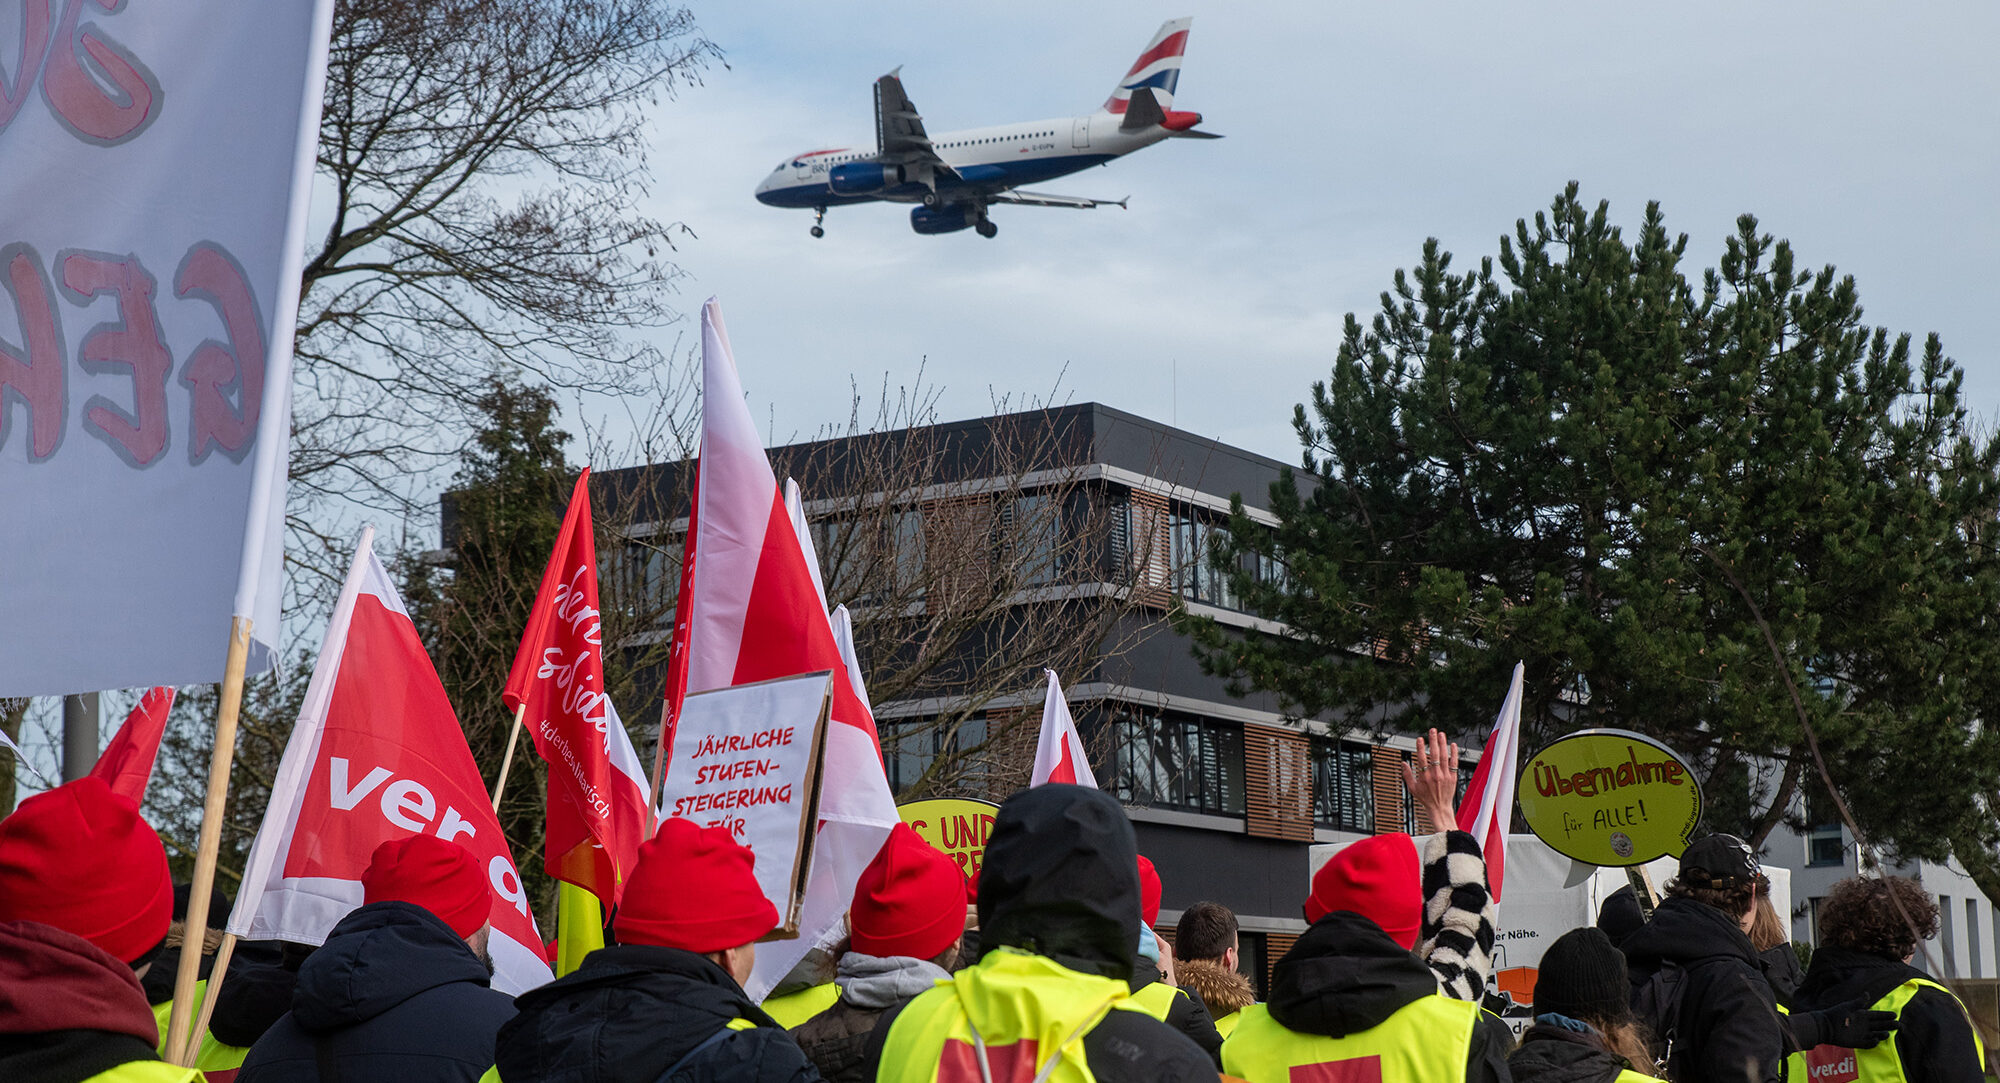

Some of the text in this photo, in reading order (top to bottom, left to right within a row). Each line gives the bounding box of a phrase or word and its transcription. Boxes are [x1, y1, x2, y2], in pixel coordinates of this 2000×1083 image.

[692, 727, 794, 759] JÄHRLICHE
[695, 759, 780, 784] STUFEN-
[1534, 746, 1684, 797] Übernahme
[672, 783, 792, 816] STEIGERUNG
[941, 814, 996, 849] UND
[1563, 799, 1648, 840] für ALLE!
[1508, 929, 1539, 939] Nähe.
[1810, 1057, 1854, 1078] ver.di
